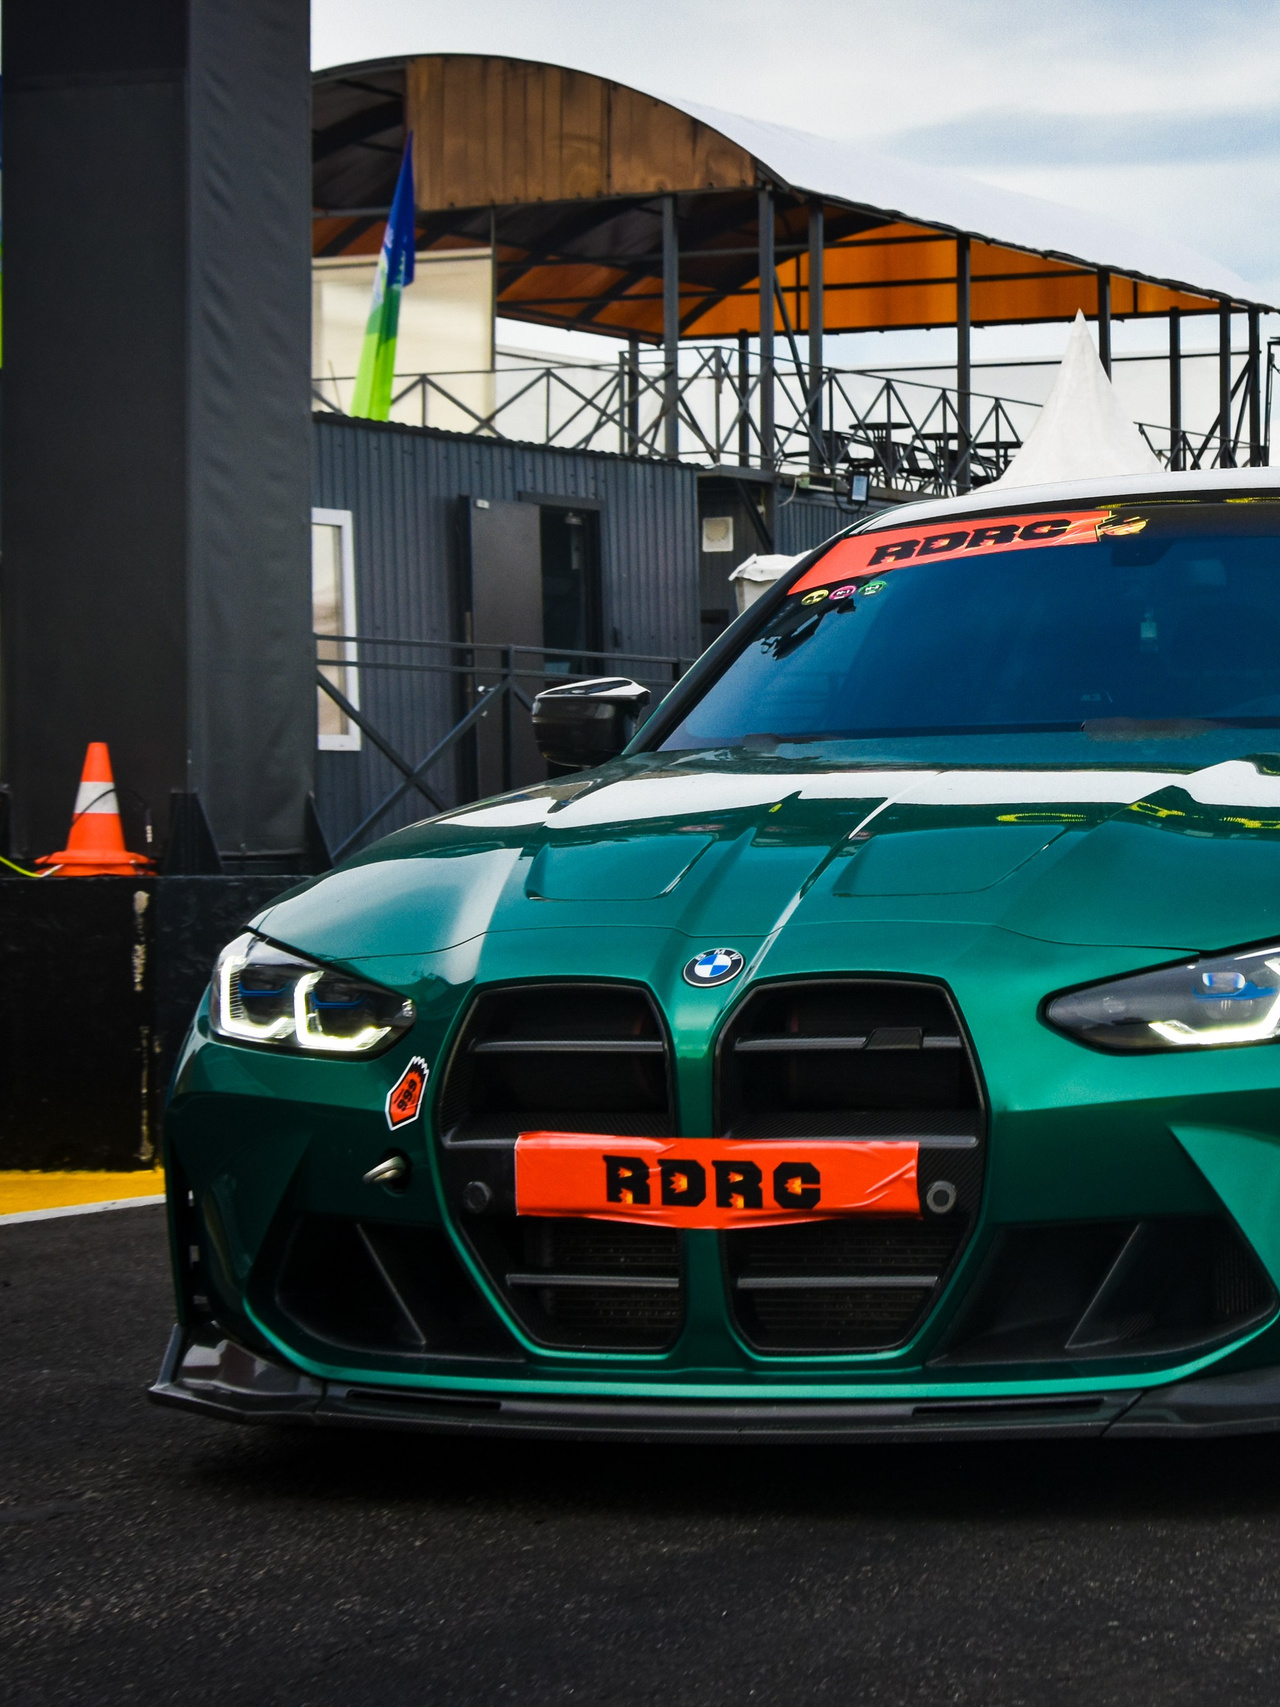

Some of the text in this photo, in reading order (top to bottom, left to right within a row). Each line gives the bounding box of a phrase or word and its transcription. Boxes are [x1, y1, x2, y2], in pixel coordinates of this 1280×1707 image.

[866, 518, 1073, 567] RDRC
[694, 948, 741, 961] BMW
[602, 1154, 822, 1210] RDRC
